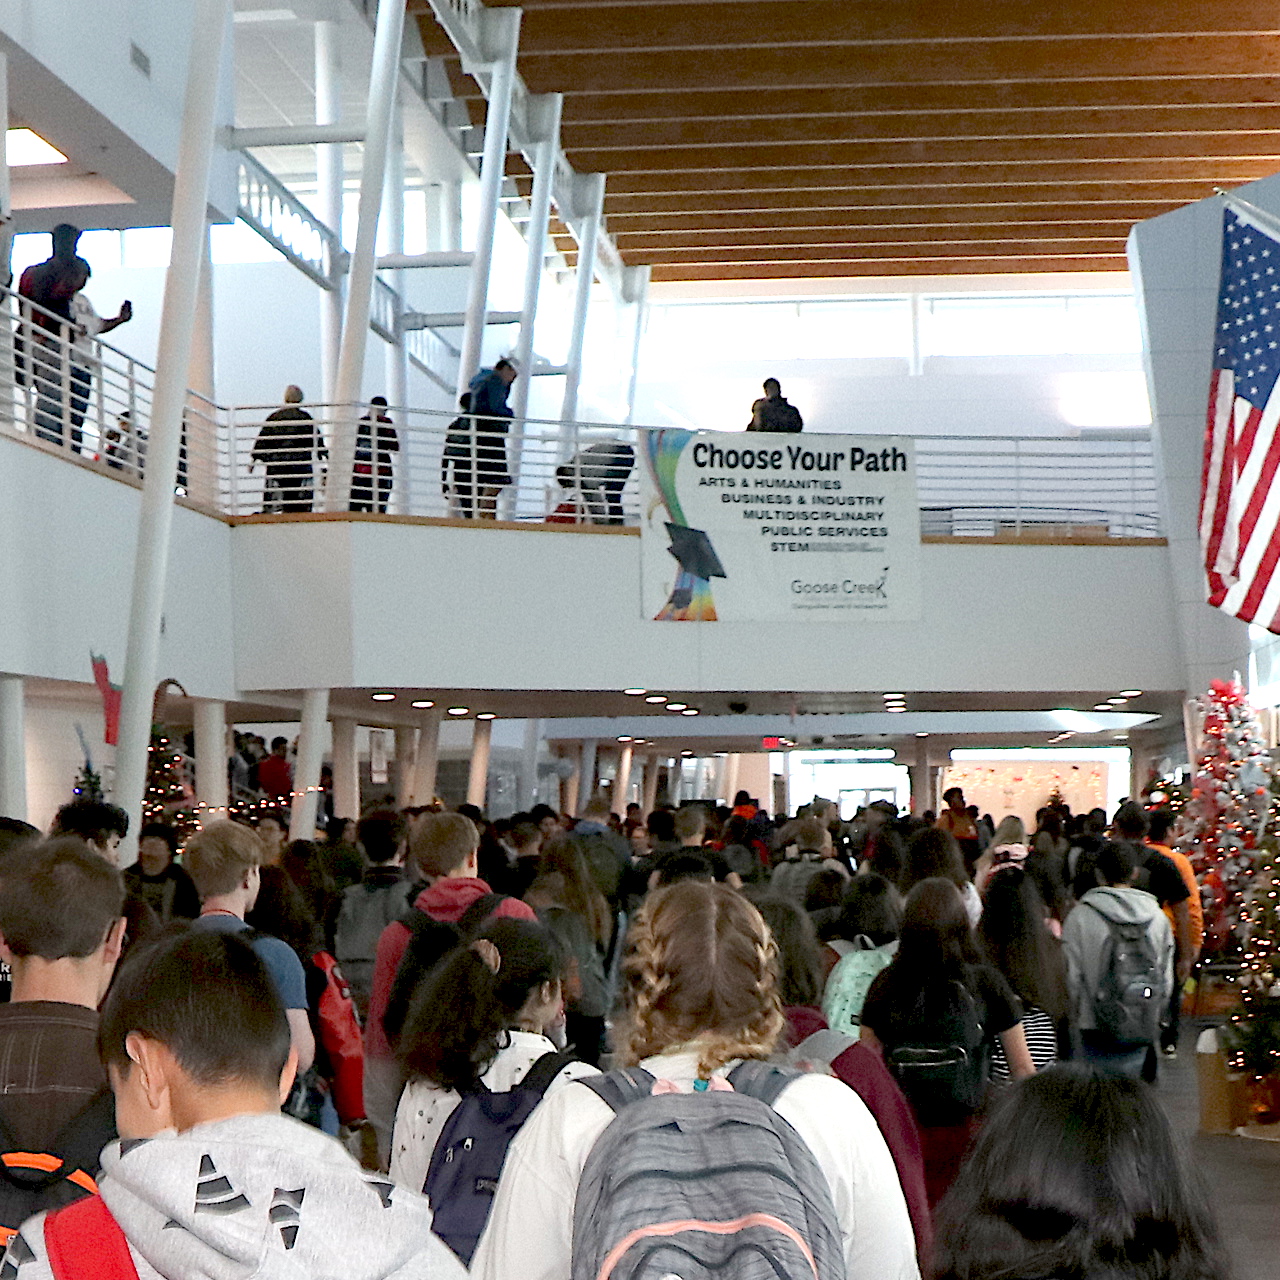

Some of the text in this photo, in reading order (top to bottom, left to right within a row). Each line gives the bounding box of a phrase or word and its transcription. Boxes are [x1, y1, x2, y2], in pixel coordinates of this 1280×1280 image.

[692, 442, 907, 472] Choose Your Path
[698, 477, 842, 490] ARTS & HUMANITIES
[721, 493, 886, 506] BUSINESS & INDUSTRY
[743, 510, 885, 521] MULTIDISCIPLINARY
[761, 526, 889, 537] PUBLIC SERVICES
[770, 541, 810, 552] STEM
[790, 576, 888, 598] Goose Creek
